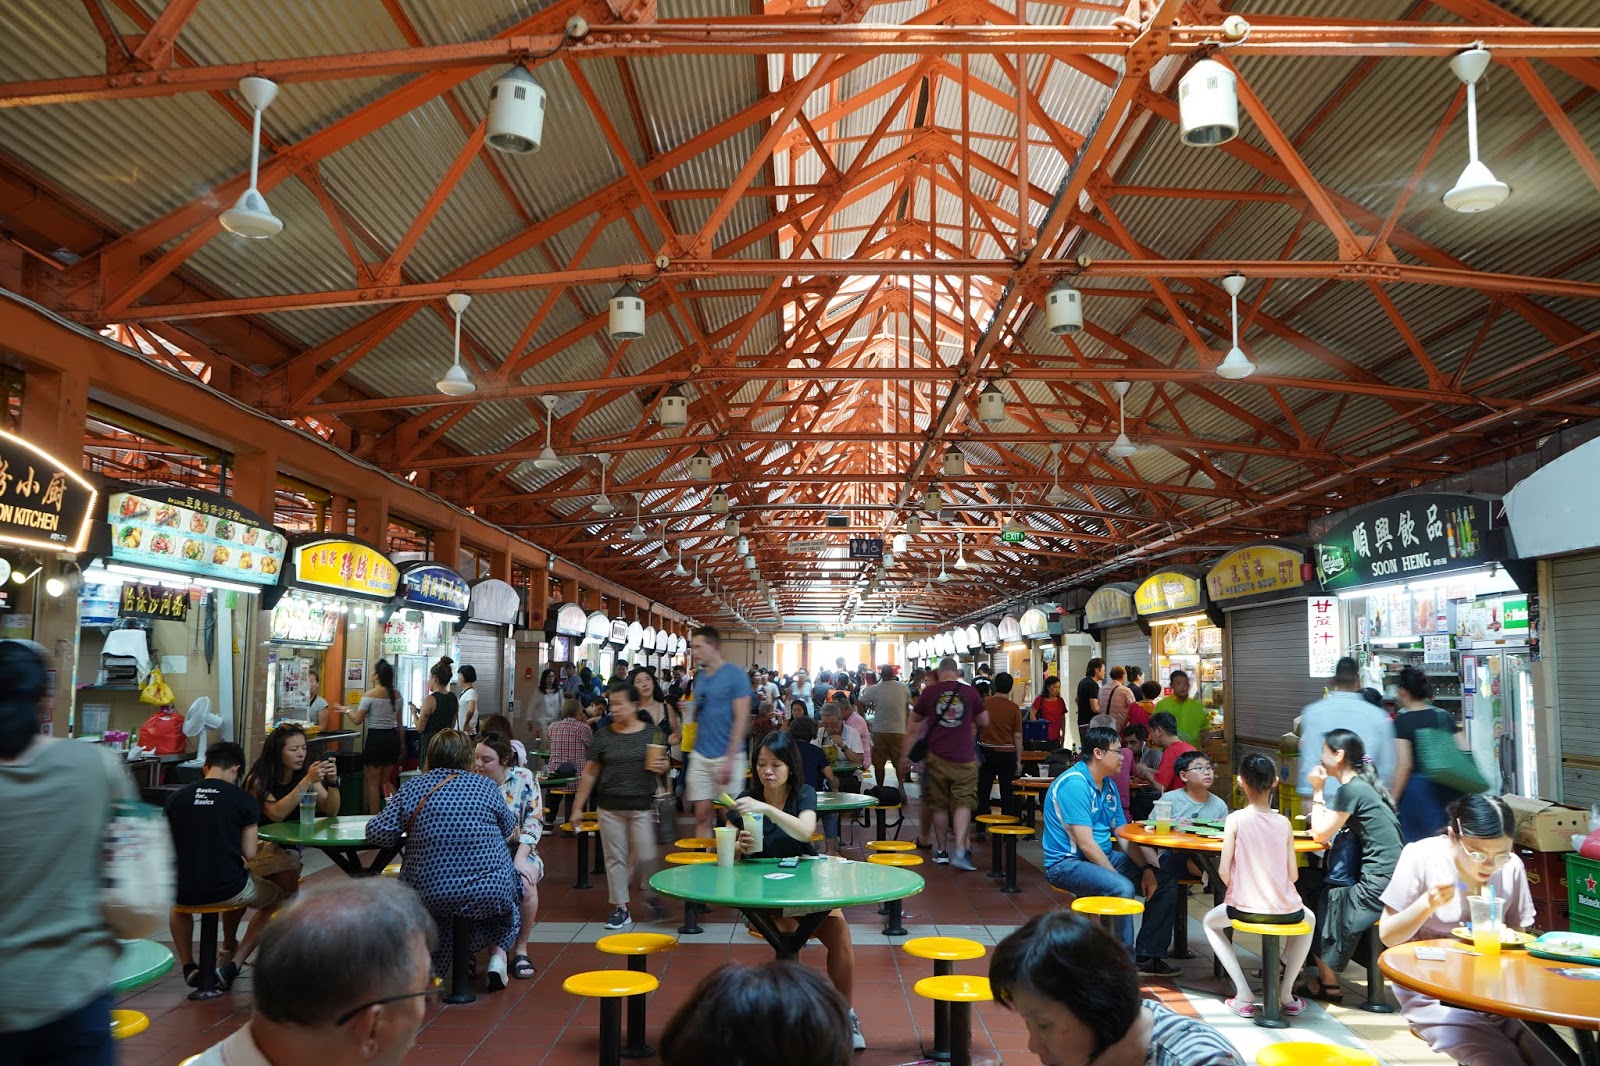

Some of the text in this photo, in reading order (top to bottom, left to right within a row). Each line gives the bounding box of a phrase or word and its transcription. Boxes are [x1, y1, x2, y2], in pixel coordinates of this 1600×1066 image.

[13, 507, 59, 532] KITCHEN
[1005, 532, 1021, 541] EXIT
[1278, 560, 1293, 583] 57
[1322, 553, 1344, 574] Carlsberg
[1371, 558, 1398, 577] SOON
[1403, 552, 1431, 571] HENG
[1312, 600, 1334, 645] 甘蔗汁
[1315, 665, 1335, 674] JUICE
